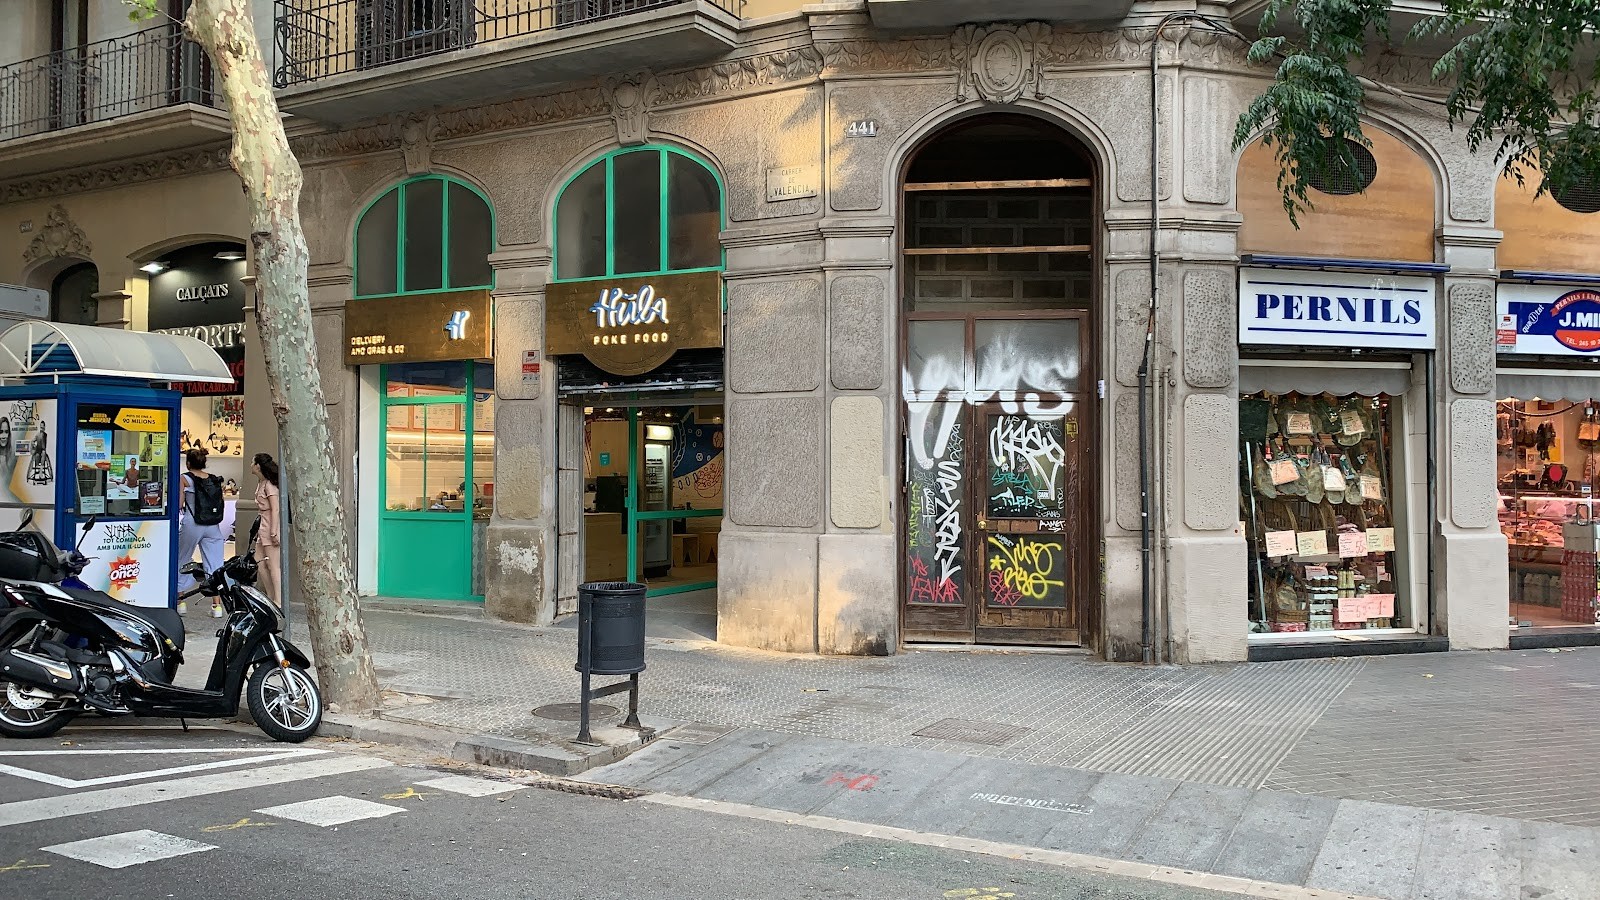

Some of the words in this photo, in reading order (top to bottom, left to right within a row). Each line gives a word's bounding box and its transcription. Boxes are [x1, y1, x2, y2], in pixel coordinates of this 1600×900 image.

[848, 121, 875, 136] 441
[782, 168, 802, 176] CARRER
[176, 283, 229, 301] CALÇATS
[1255, 293, 1421, 325] PERNILS
[351, 335, 386, 346] DELIVERY
[593, 333, 627, 345] POKE
[634, 332, 669, 344] FOOD
[351, 347, 366, 356] AND
[366, 346, 386, 355] GRAB
[387, 345, 393, 354] &
[394, 344, 405, 353] GO
[187, 381, 239, 394] TANCAMENT
[118, 561, 140, 571] Super
[110, 568, 140, 581] Once
